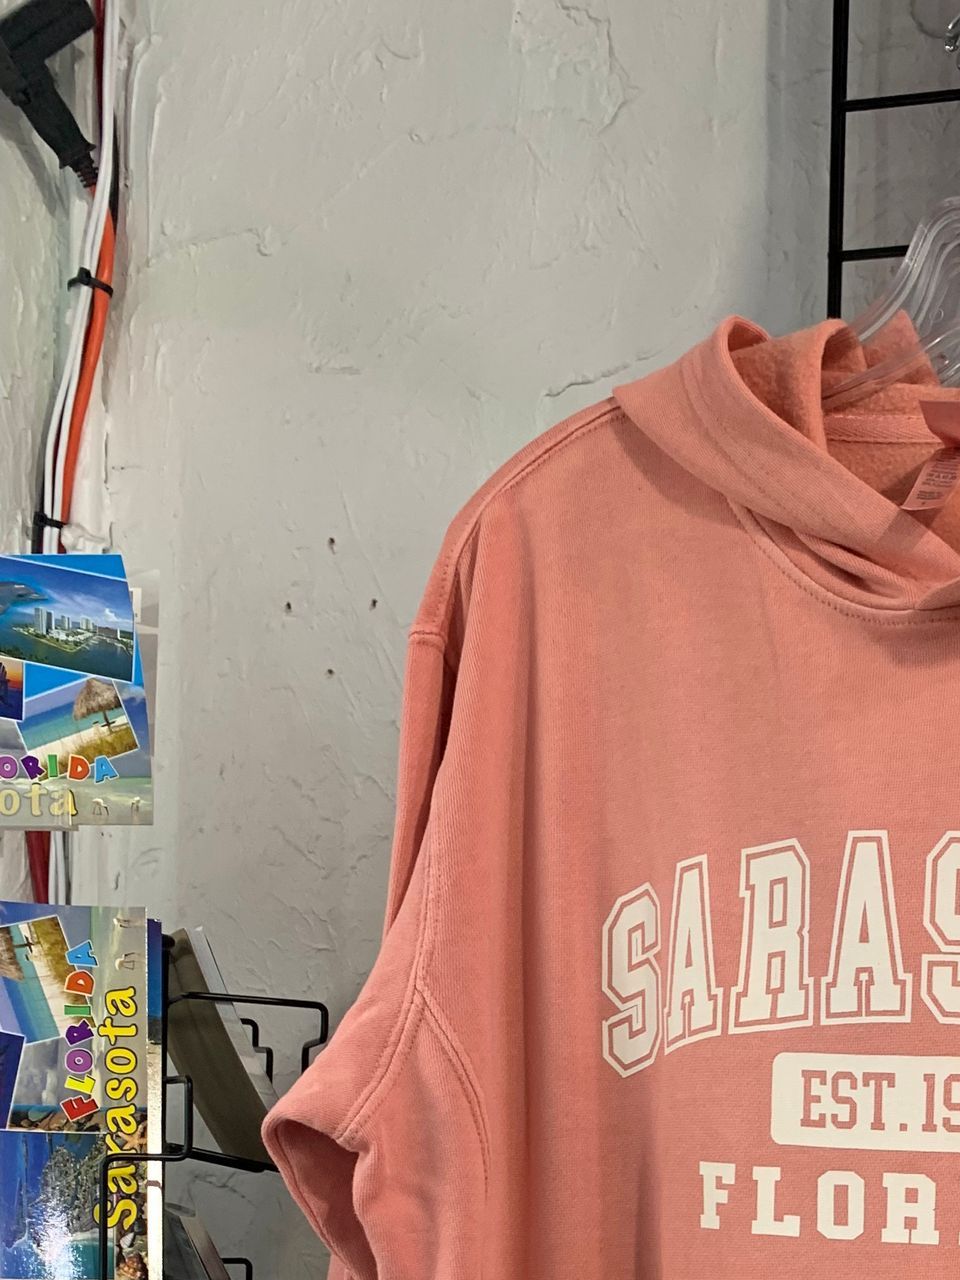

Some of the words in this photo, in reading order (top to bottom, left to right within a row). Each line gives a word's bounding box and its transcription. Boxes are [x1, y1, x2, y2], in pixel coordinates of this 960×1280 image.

[0, 754, 119, 784] ORIDA
[0, 782, 79, 817] ota
[60, 940, 99, 1121] FLORIDA
[94, 986, 138, 1230] Sarasota
